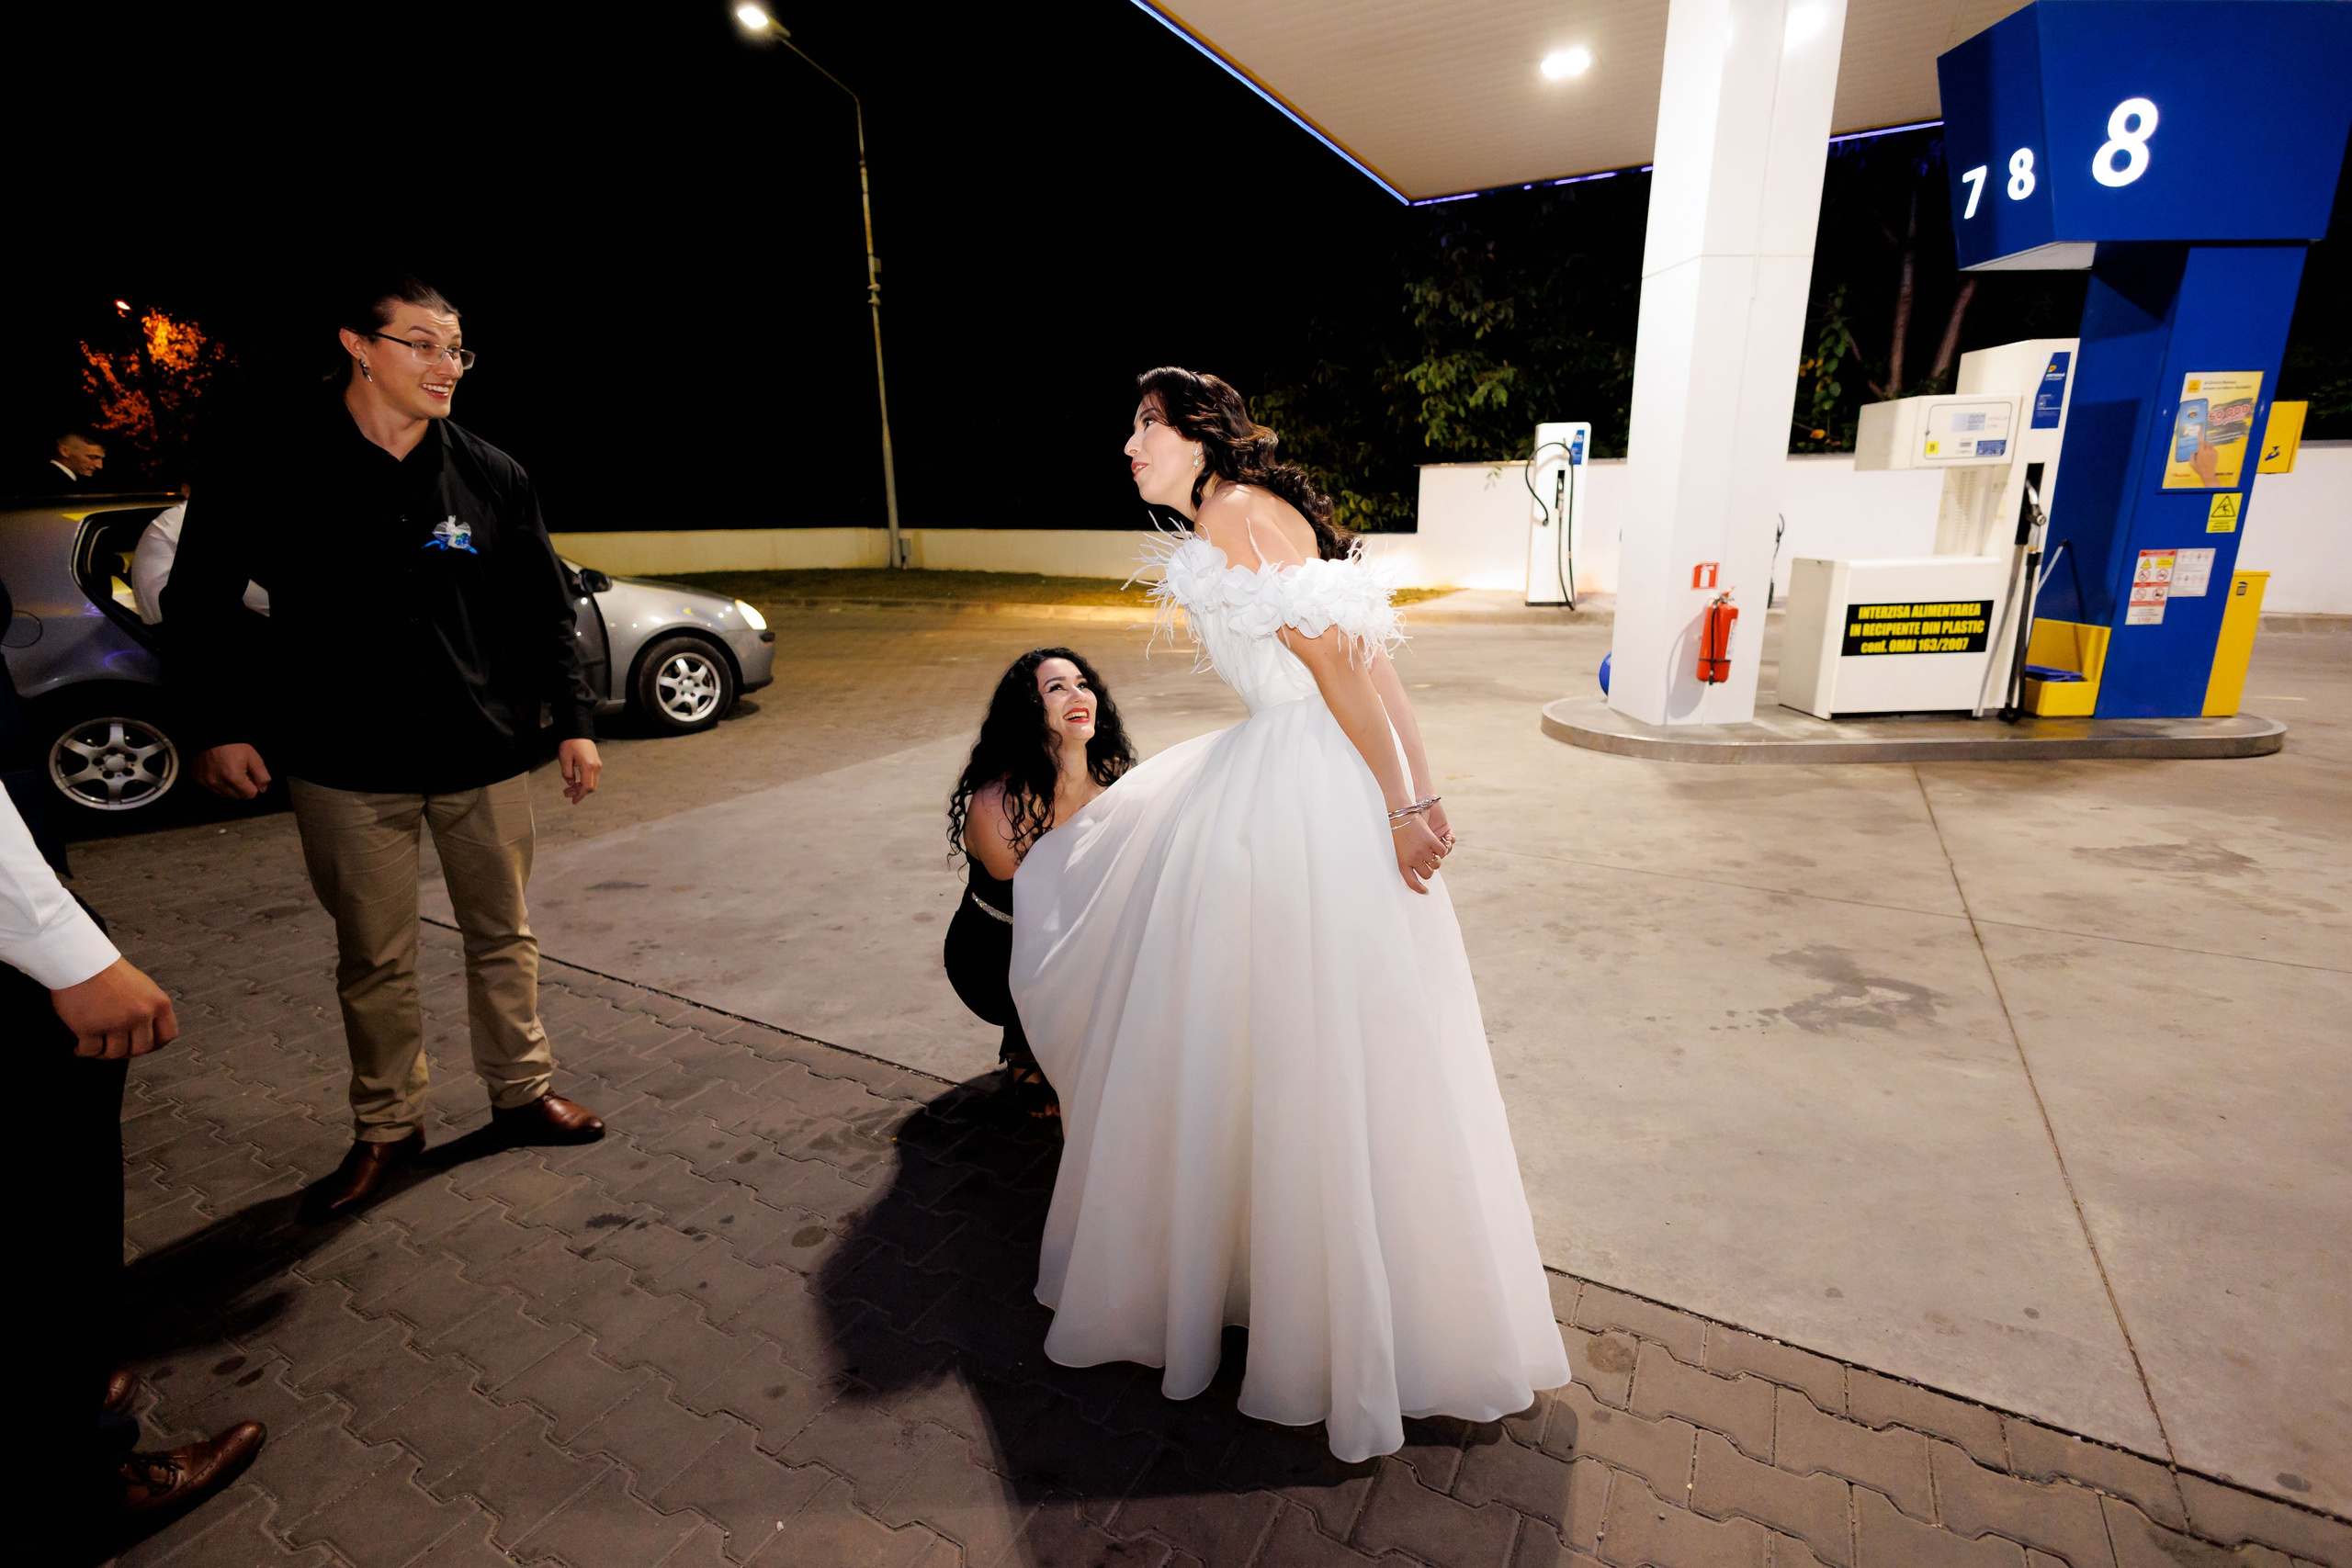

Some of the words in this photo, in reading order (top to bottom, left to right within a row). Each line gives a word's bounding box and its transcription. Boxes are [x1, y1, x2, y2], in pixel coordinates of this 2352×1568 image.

[2092, 97, 2159, 187] 8
[1962, 164, 1987, 220] 7
[2007, 147, 2036, 201] 8
[1858, 605, 1910, 620] INTERZISA
[1911, 603, 1981, 617] ALIMENTAREA
[1849, 623, 1861, 637] IN
[1862, 622, 1920, 636] RECIPIENTE
[1921, 621, 1941, 635] DIN
[1941, 620, 1985, 634] PLASTIC
[1860, 640, 1887, 653] conf.
[1918, 637, 1969, 651] 163/2007
